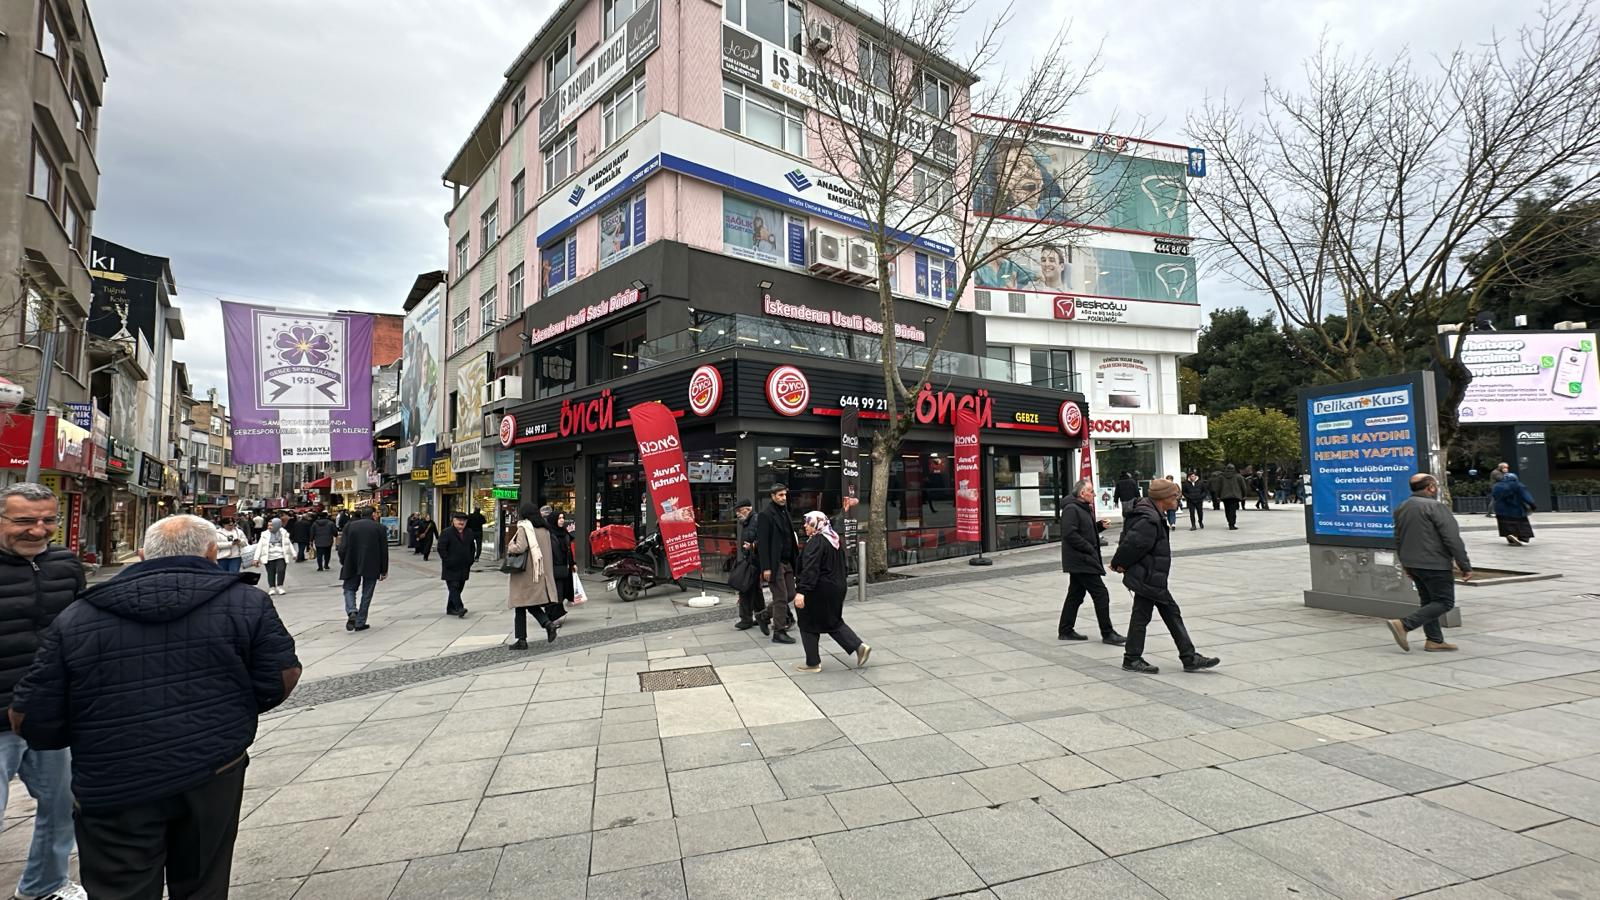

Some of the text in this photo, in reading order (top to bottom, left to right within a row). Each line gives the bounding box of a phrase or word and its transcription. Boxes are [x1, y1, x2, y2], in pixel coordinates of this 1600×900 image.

[773, 50, 790, 83] İŞ
[567, 62, 595, 104] BAŞVURU
[588, 161, 613, 186] ANADOLU
[613, 148, 629, 168] HAYAT
[817, 179, 853, 198] ANADOLU
[764, 294, 831, 326] İskenderun
[864, 316, 885, 335] Sos
[291, 376, 316, 385] 1955
[839, 394, 888, 411] 644 99 21
[1316, 394, 1405, 413] Pelikan Kurs
[1015, 412, 1039, 424] GEBZE
[1316, 429, 1410, 446] KURS KAYDINI
[1314, 446, 1415, 461] HEMEN YAPTIR
[1319, 464, 1409, 474] Deneme kulübümüze
[1334, 476, 1368, 484] ücretsiz
[1340, 492, 1386, 501] SON GÜN
[1340, 505, 1389, 513] 31 ARALIK
